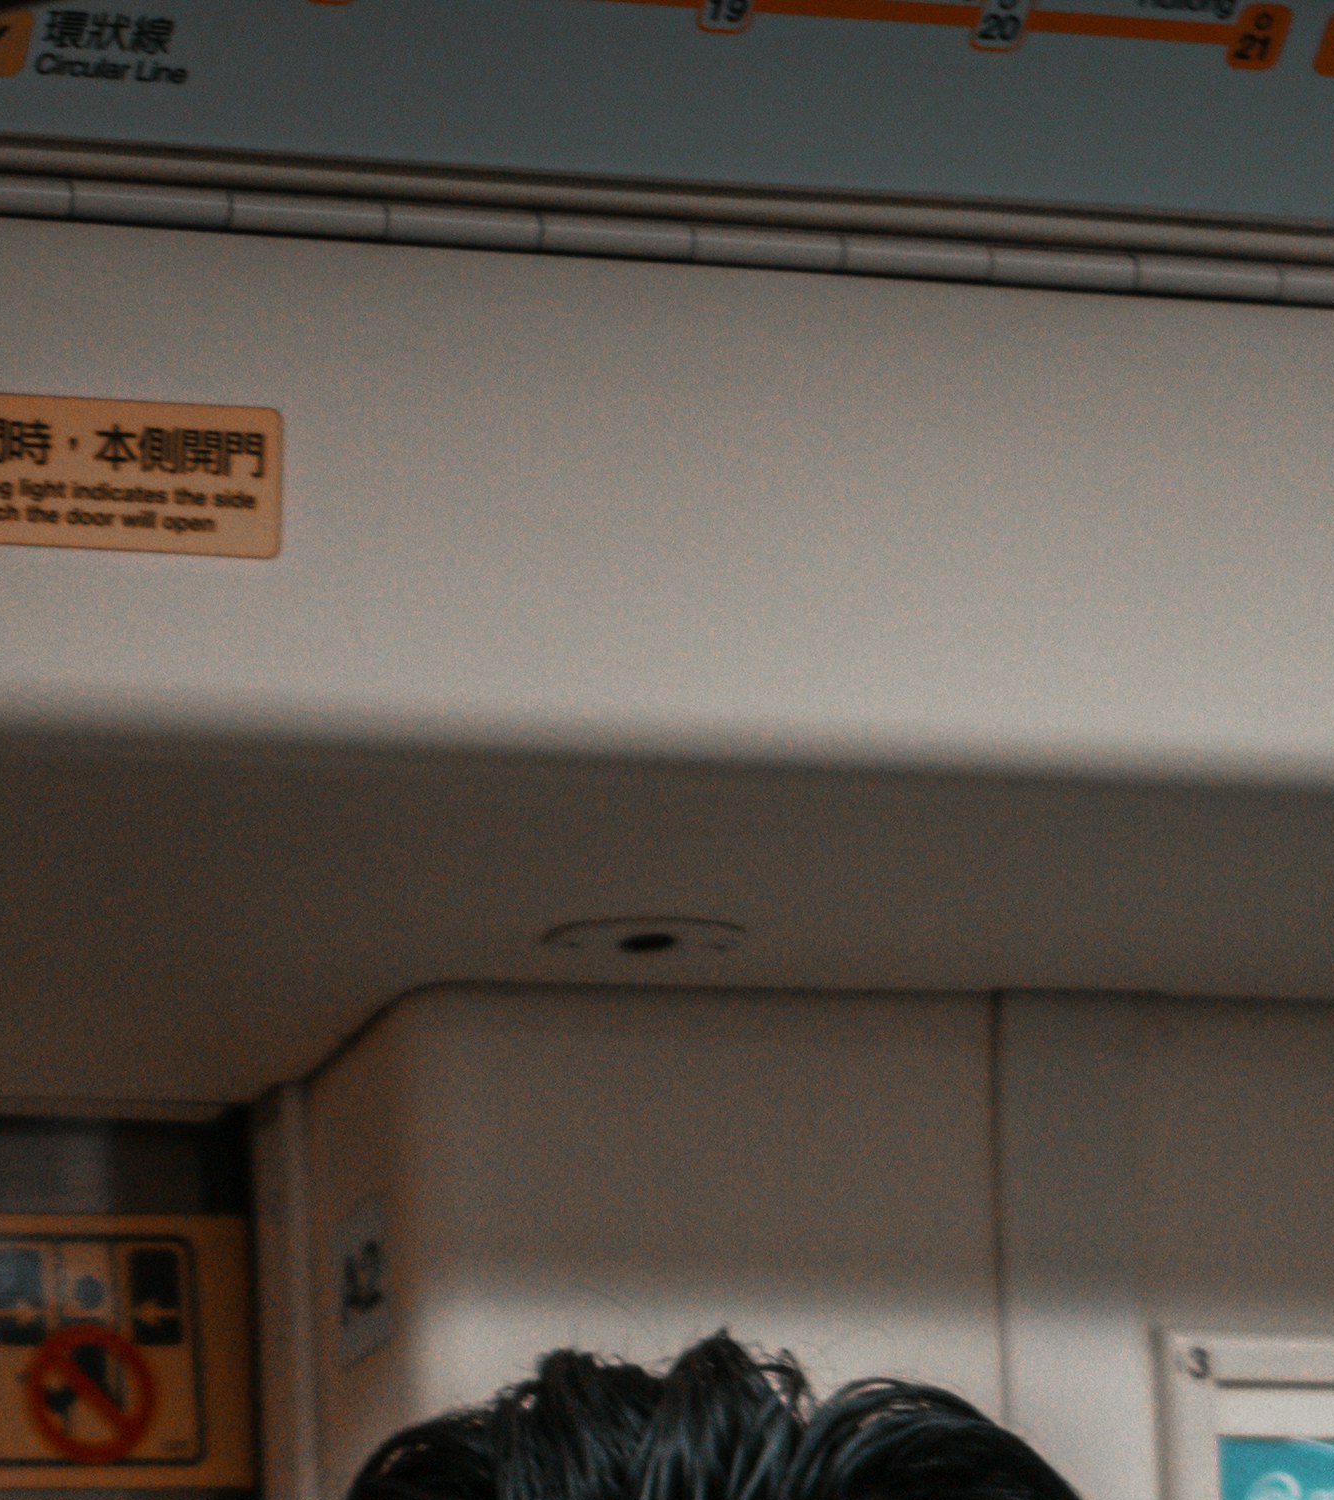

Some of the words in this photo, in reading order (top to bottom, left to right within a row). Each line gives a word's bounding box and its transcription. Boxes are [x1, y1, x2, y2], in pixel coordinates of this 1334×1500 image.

[43, 10, 174, 54] 環狀線
[979, 13, 1021, 41] 20
[1234, 33, 1272, 61] 21
[35, 53, 128, 80] Circular
[134, 61, 188, 84] Line
[20, 478, 66, 502] light
[71, 482, 167, 506] indicates
[174, 487, 207, 507] the
[213, 491, 257, 511] side
[25, 504, 59, 524] the
[65, 507, 115, 527] door
[119, 510, 157, 529] will
[161, 515, 216, 533] open
